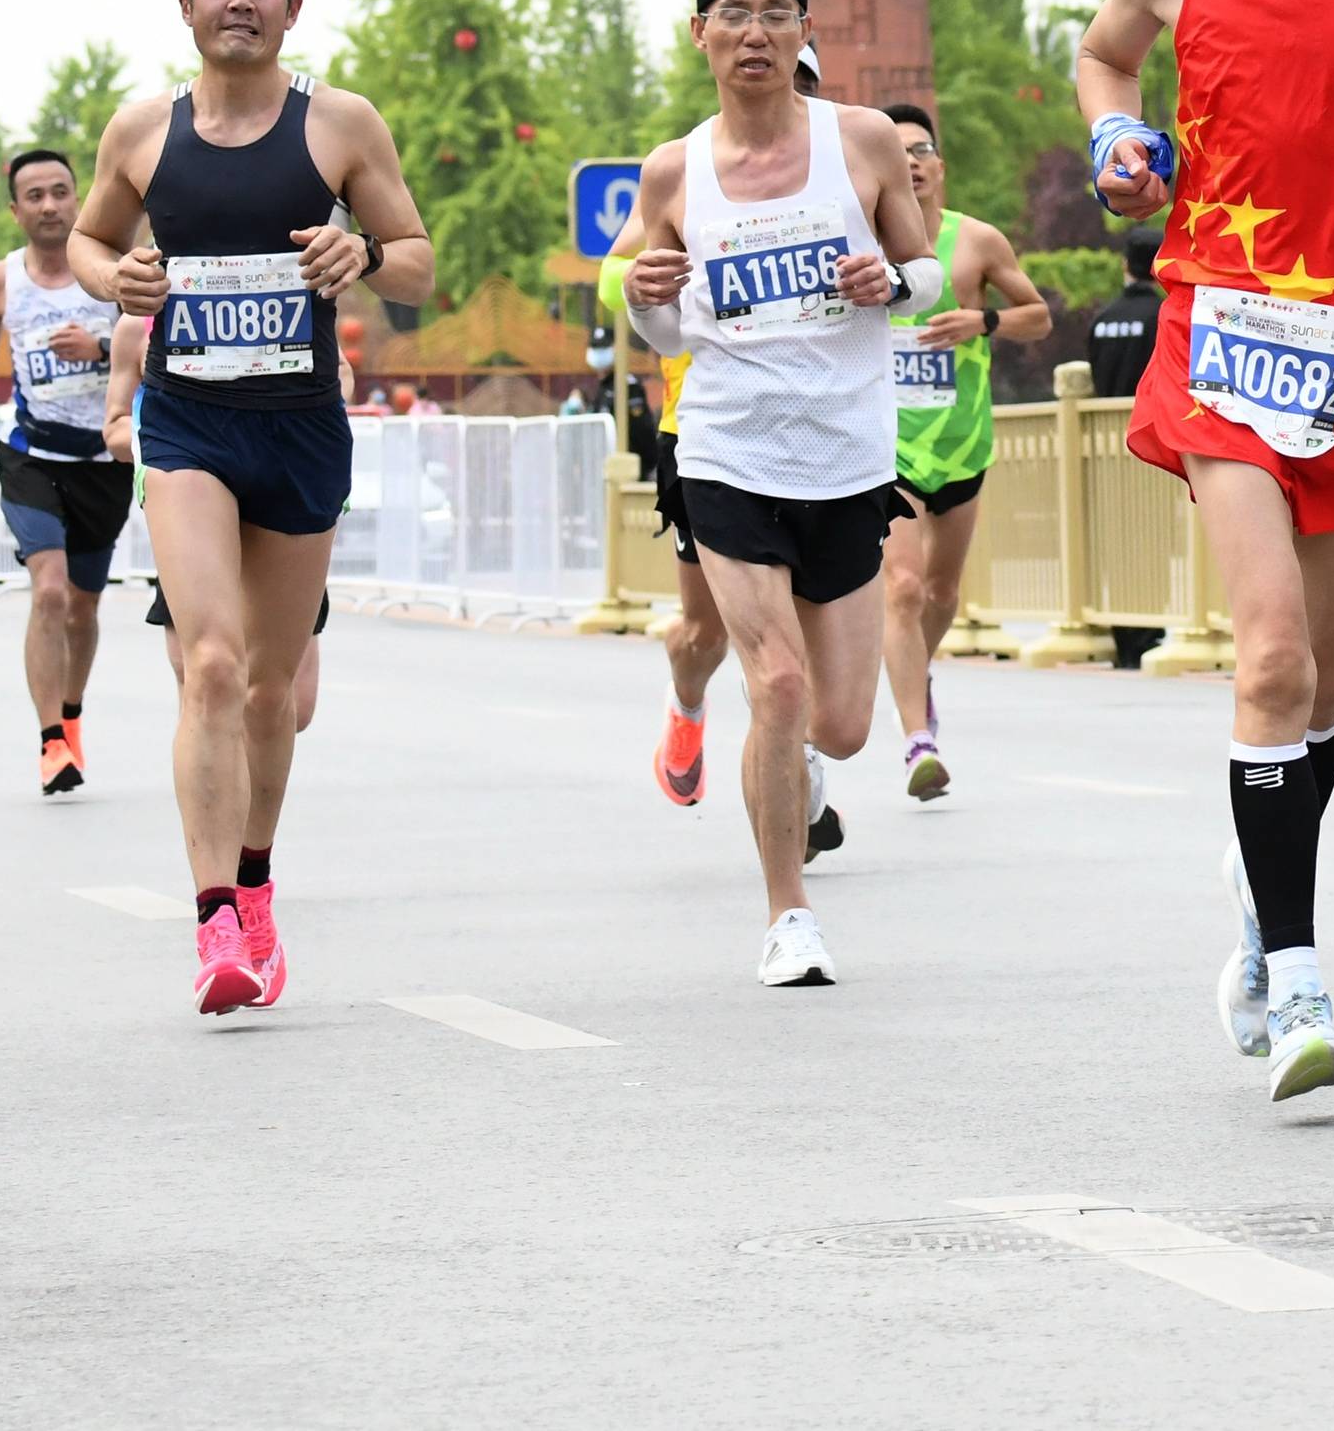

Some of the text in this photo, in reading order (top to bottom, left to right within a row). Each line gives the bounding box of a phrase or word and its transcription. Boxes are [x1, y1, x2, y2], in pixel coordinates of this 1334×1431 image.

[722, 245, 839, 306] A11156
[169, 296, 306, 342] A10887
[1246, 321, 1286, 335] MARATHON
